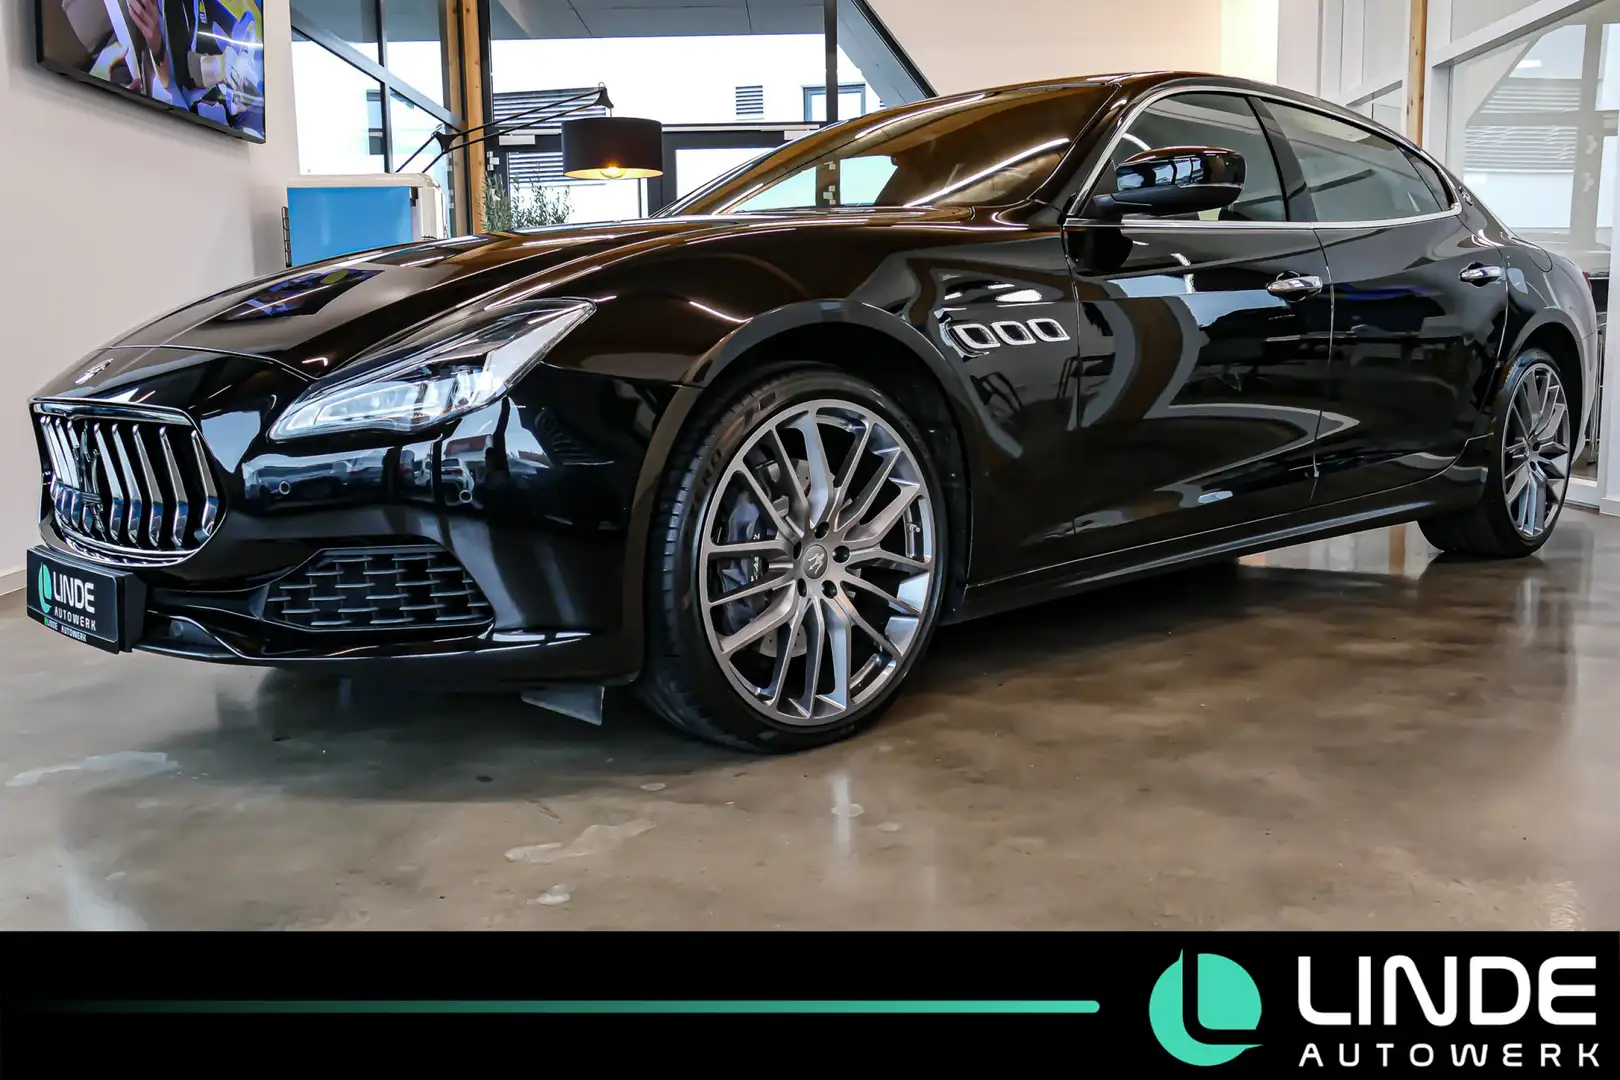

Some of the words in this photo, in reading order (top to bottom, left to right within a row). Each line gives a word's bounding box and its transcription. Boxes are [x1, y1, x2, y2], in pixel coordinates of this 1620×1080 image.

[52, 571, 96, 614] LINDE
[54, 606, 97, 632] AUTOWERK
[60, 625, 88, 643] AUTOWERK
